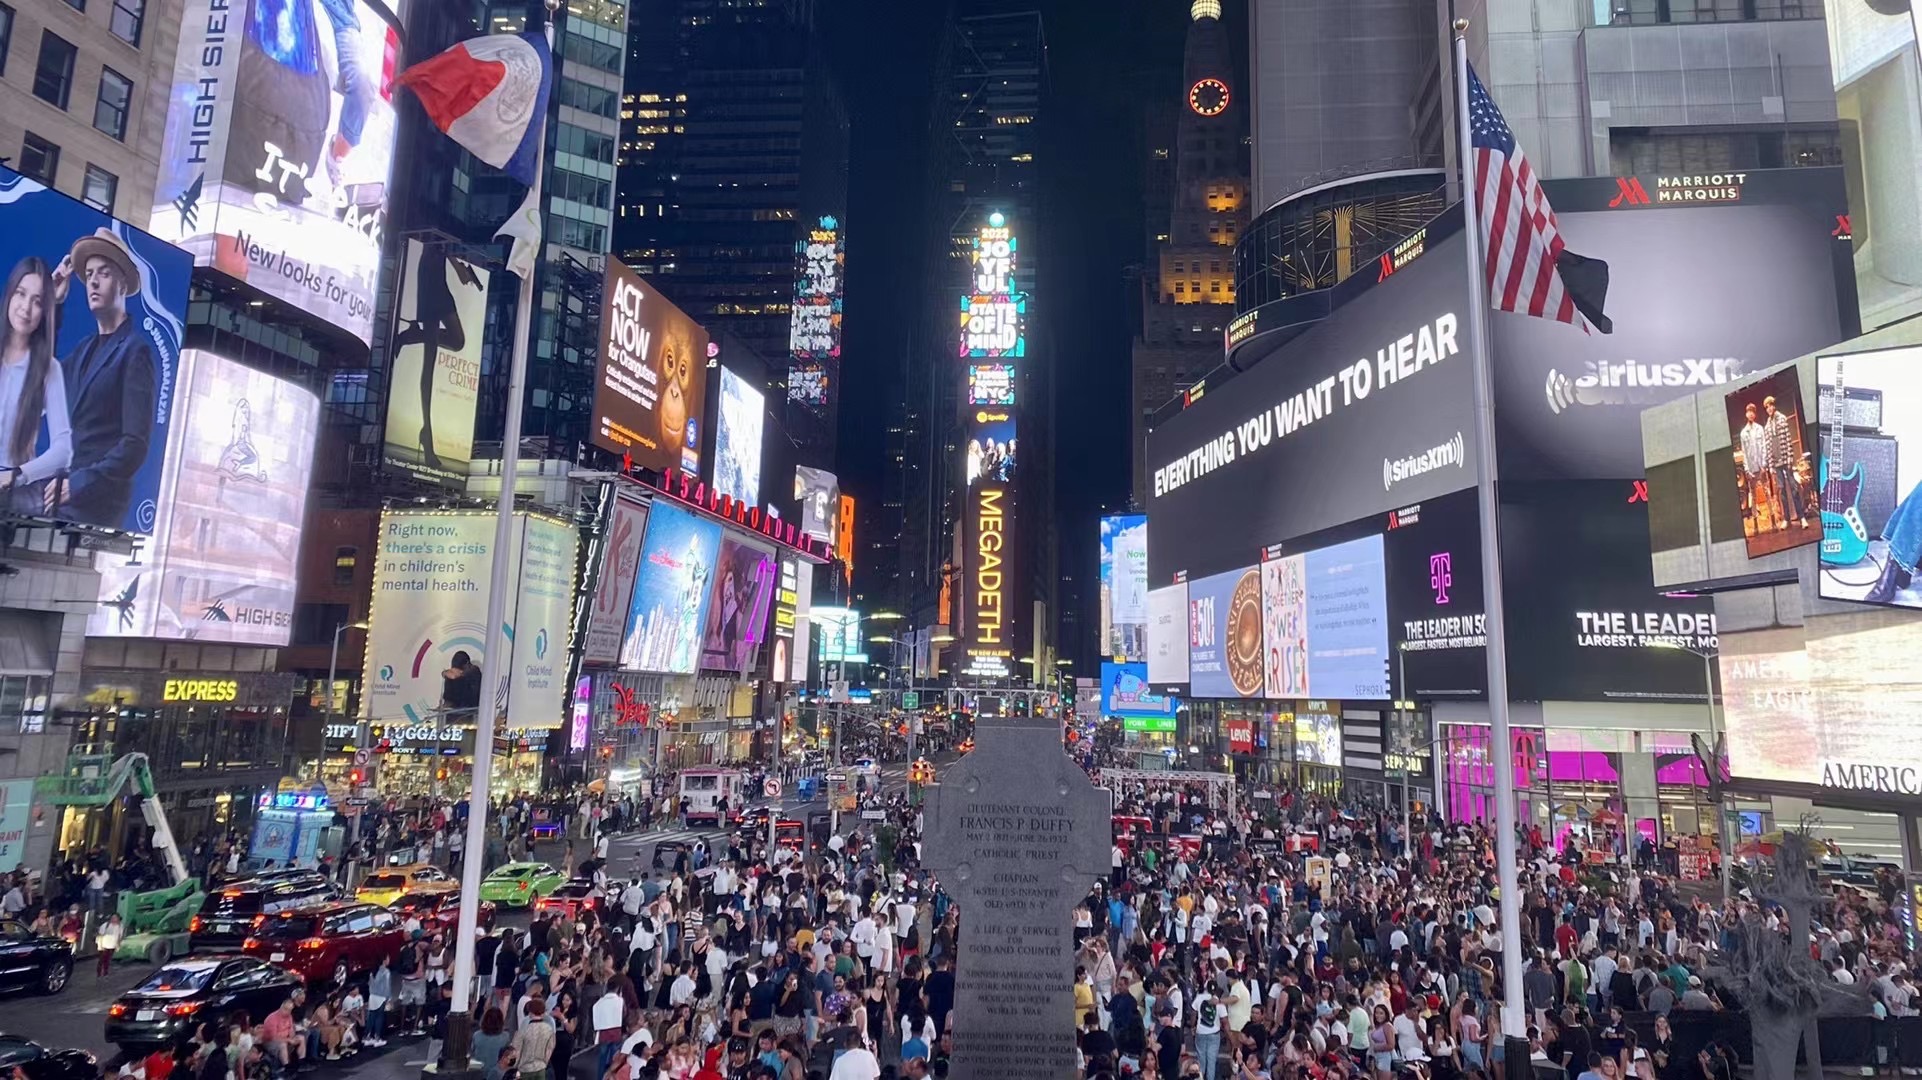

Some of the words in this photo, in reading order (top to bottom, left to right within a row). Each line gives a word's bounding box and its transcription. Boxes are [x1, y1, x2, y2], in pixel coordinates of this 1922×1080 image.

[187, 78, 218, 163] HIGH
[1658, 174, 1746, 188] MARRIOTT
[1658, 187, 1738, 201] MARQUIS
[1394, 228, 1426, 257] MARRIOTT
[1394, 243, 1424, 269] MARQUIS
[234, 229, 277, 270] New
[278, 251, 323, 294] looks
[325, 276, 348, 306] for
[612, 277, 644, 322] ACT
[1230, 310, 1259, 333] MARRIOTT
[610, 308, 651, 360] NOW
[1230, 324, 1256, 344] MARQUIS
[607, 342, 620, 361] for
[438, 352, 480, 377] PERFECT
[448, 370, 478, 391] CRIME
[1154, 431, 1236, 498] EVERYTHING
[1237, 410, 1273, 452] YOU
[1274, 376, 1335, 438] WANT
[1339, 358, 1373, 406] TO
[1377, 312, 1459, 390] HEAR
[663, 468, 717, 512] 1540
[723, 494, 812, 552] BROADWAY
[388, 523, 424, 538] Right
[386, 542, 434, 554] there's
[436, 545, 446, 554] a
[449, 542, 486, 555] crisis
[1127, 550, 1146, 559] Now
[384, 560, 396, 572] in
[399, 560, 466, 573] children's
[977, 490, 1003, 643] MEGADETH
[382, 579, 429, 591] mental
[432, 579, 480, 592] health.
[235, 607, 271, 626] HIGH
[1576, 612, 1626, 634] THE
[1404, 621, 1423, 640] THE
[1423, 616, 1461, 639] LEADER
[1461, 615, 1474, 636] IN
[1427, 638, 1448, 649] FASTEST.
[1449, 637, 1464, 649] MOST
[1578, 634, 1637, 647] LARGEST.
[1638, 635, 1696, 648] FASTEST.
[526, 665, 540, 676] Child
[540, 666, 552, 676] Mind
[1271, 645, 1302, 695] RISE
[163, 680, 237, 702] EXPRESS
[527, 678, 549, 689] Institute
[1355, 684, 1385, 696] SEPHORA
[383, 726, 463, 742] LUGGAGE
[1823, 763, 1922, 795] AMERIC
[967, 804, 1021, 815] LIEUTENANT
[1023, 805, 1064, 816] COLONEL
[960, 816, 1014, 830] FRANCIS
[1030, 818, 1075, 832] DUFFY
[966, 833, 984, 841] MAY
[973, 849, 1019, 859] CATHOLIC
[1025, 850, 1060, 860] PRIEST
[984, 900, 1003, 909] OLD
[983, 925, 1003, 935] LIFE
[1005, 925, 1019, 935] OF
[1022, 926, 1060, 937] SERVICE
[1007, 936, 1023, 944] FOR
[968, 945, 992, 954] GOD
[993, 945, 1015, 955] AND
[1017, 945, 1062, 957] COUNTRY
